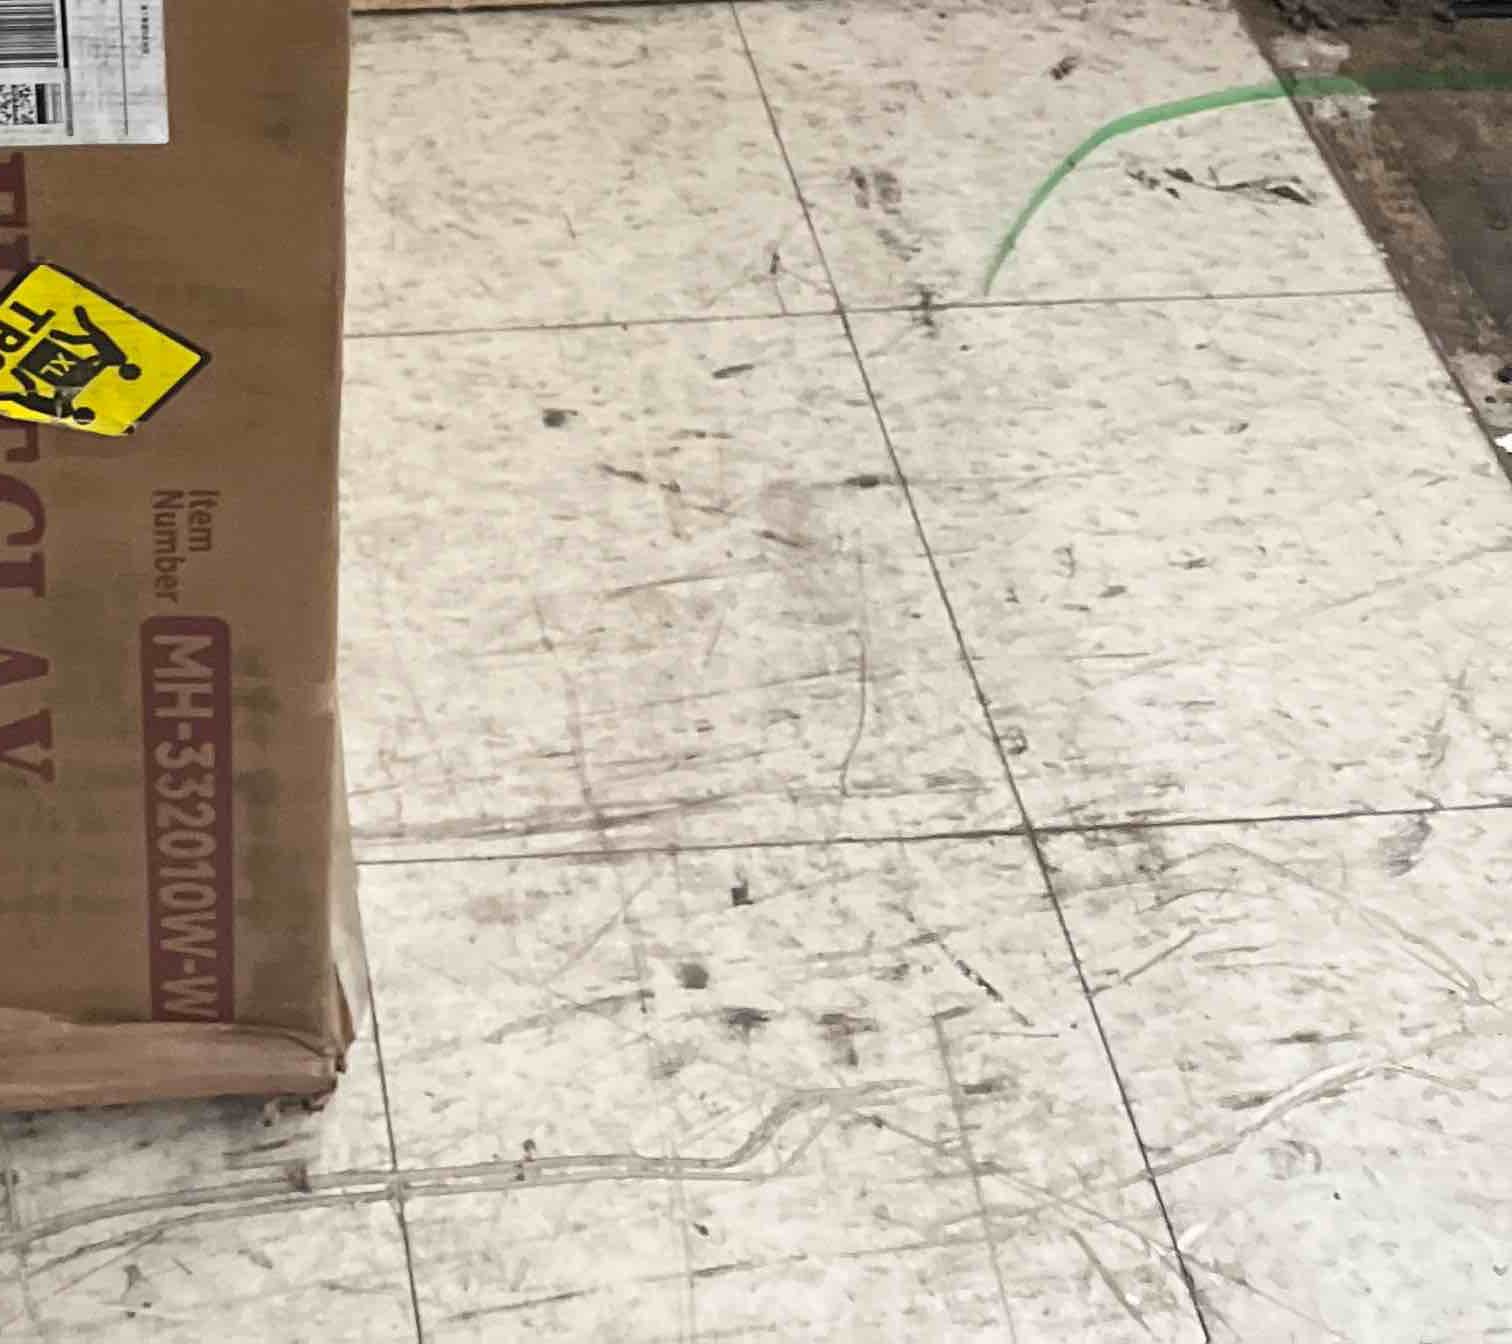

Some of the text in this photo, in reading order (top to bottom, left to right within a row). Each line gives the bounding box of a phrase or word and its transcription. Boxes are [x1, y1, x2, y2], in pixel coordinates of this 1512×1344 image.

[40, 352, 78, 379] XL
[152, 489, 187, 604] Number
[188, 489, 221, 552] Item
[152, 633, 222, 1021] MH-332010W-W
